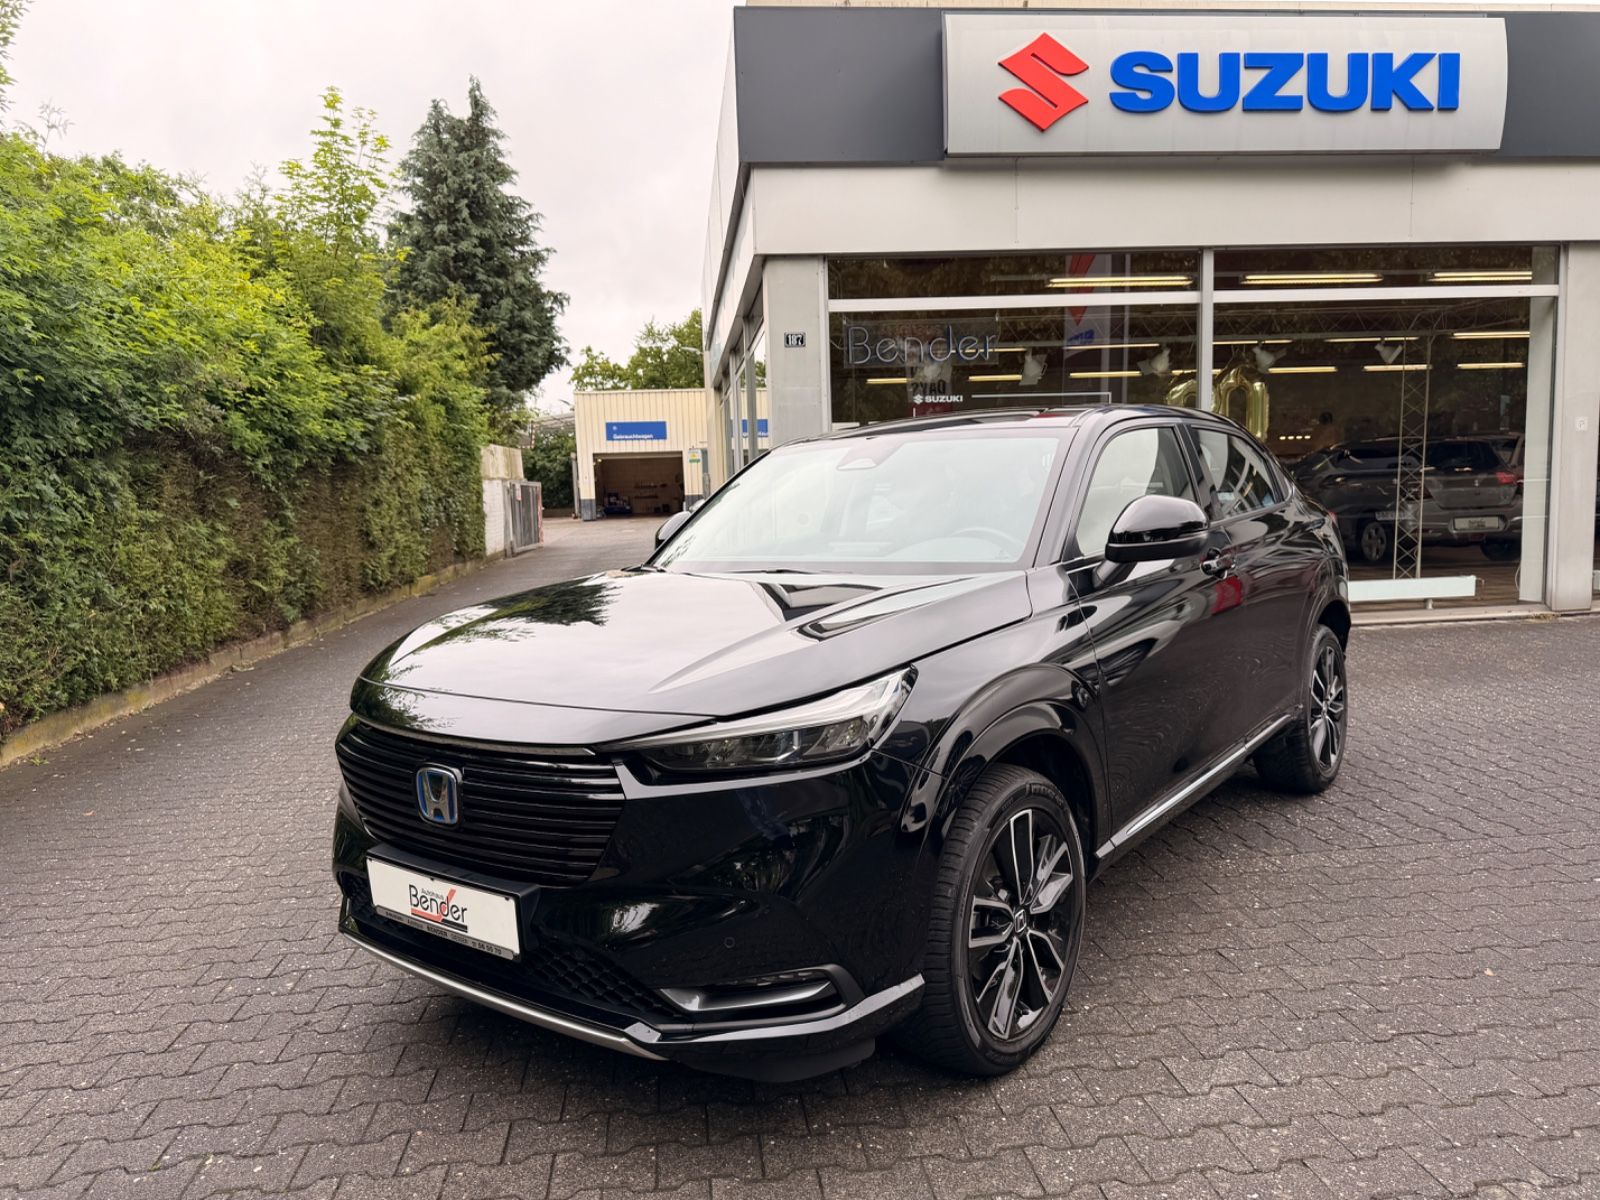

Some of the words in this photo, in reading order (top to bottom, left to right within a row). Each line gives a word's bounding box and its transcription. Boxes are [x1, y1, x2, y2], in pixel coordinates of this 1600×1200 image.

[1109, 51, 1461, 113] SUZUKI
[788, 334, 802, 345] 187
[849, 325, 996, 364] Bender
[924, 395, 964, 403] SUZUKI
[409, 884, 467, 922] Bender
